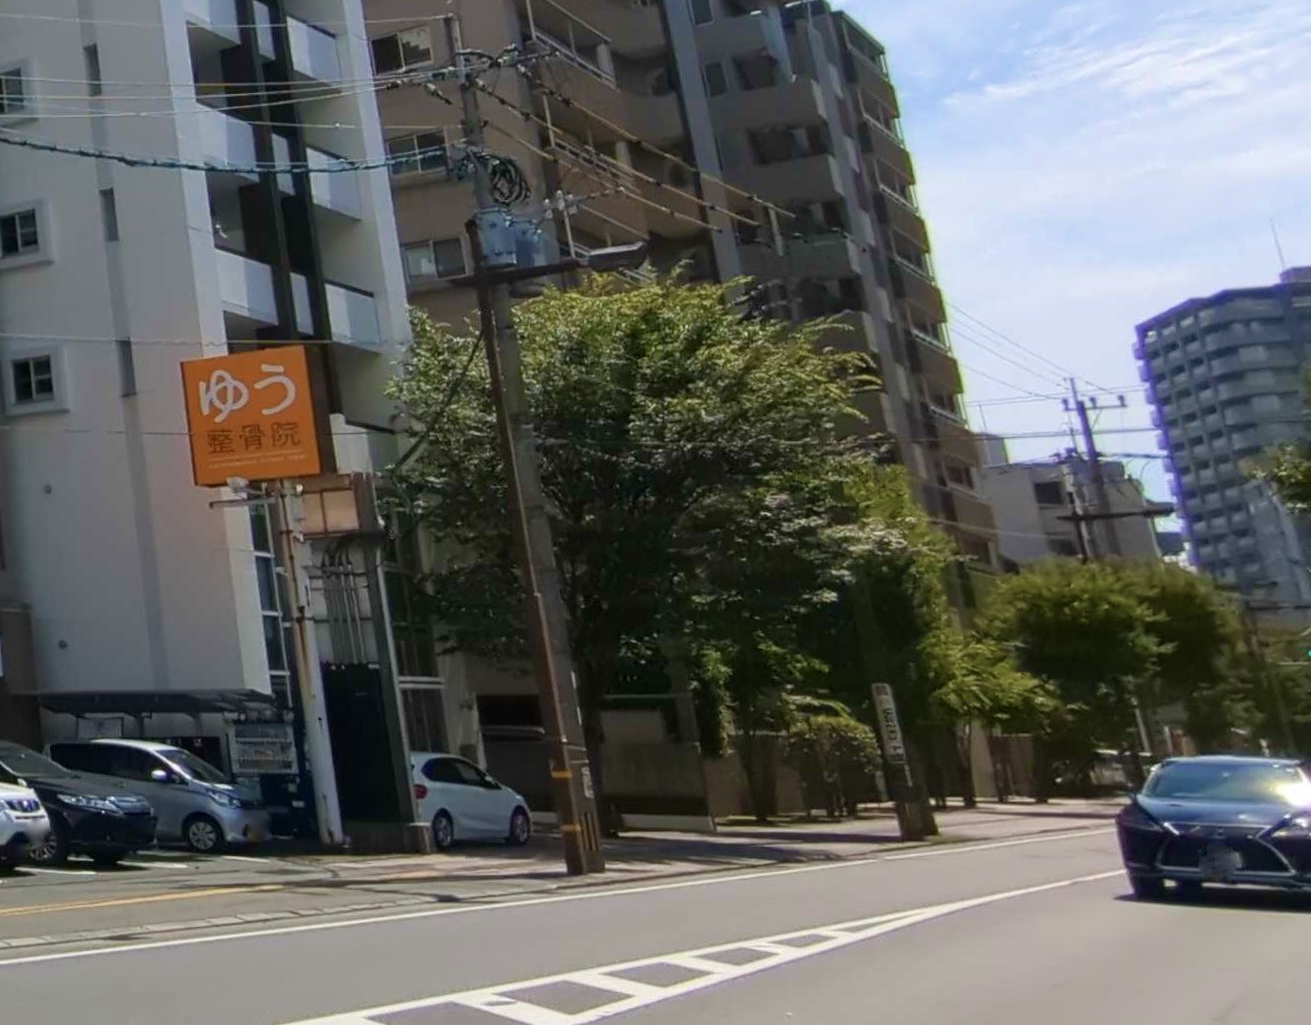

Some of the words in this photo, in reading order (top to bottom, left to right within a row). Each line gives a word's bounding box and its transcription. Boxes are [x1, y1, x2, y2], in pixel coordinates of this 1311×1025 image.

[198, 364, 296, 424] ゆう
[206, 422, 302, 454] 整骨院
